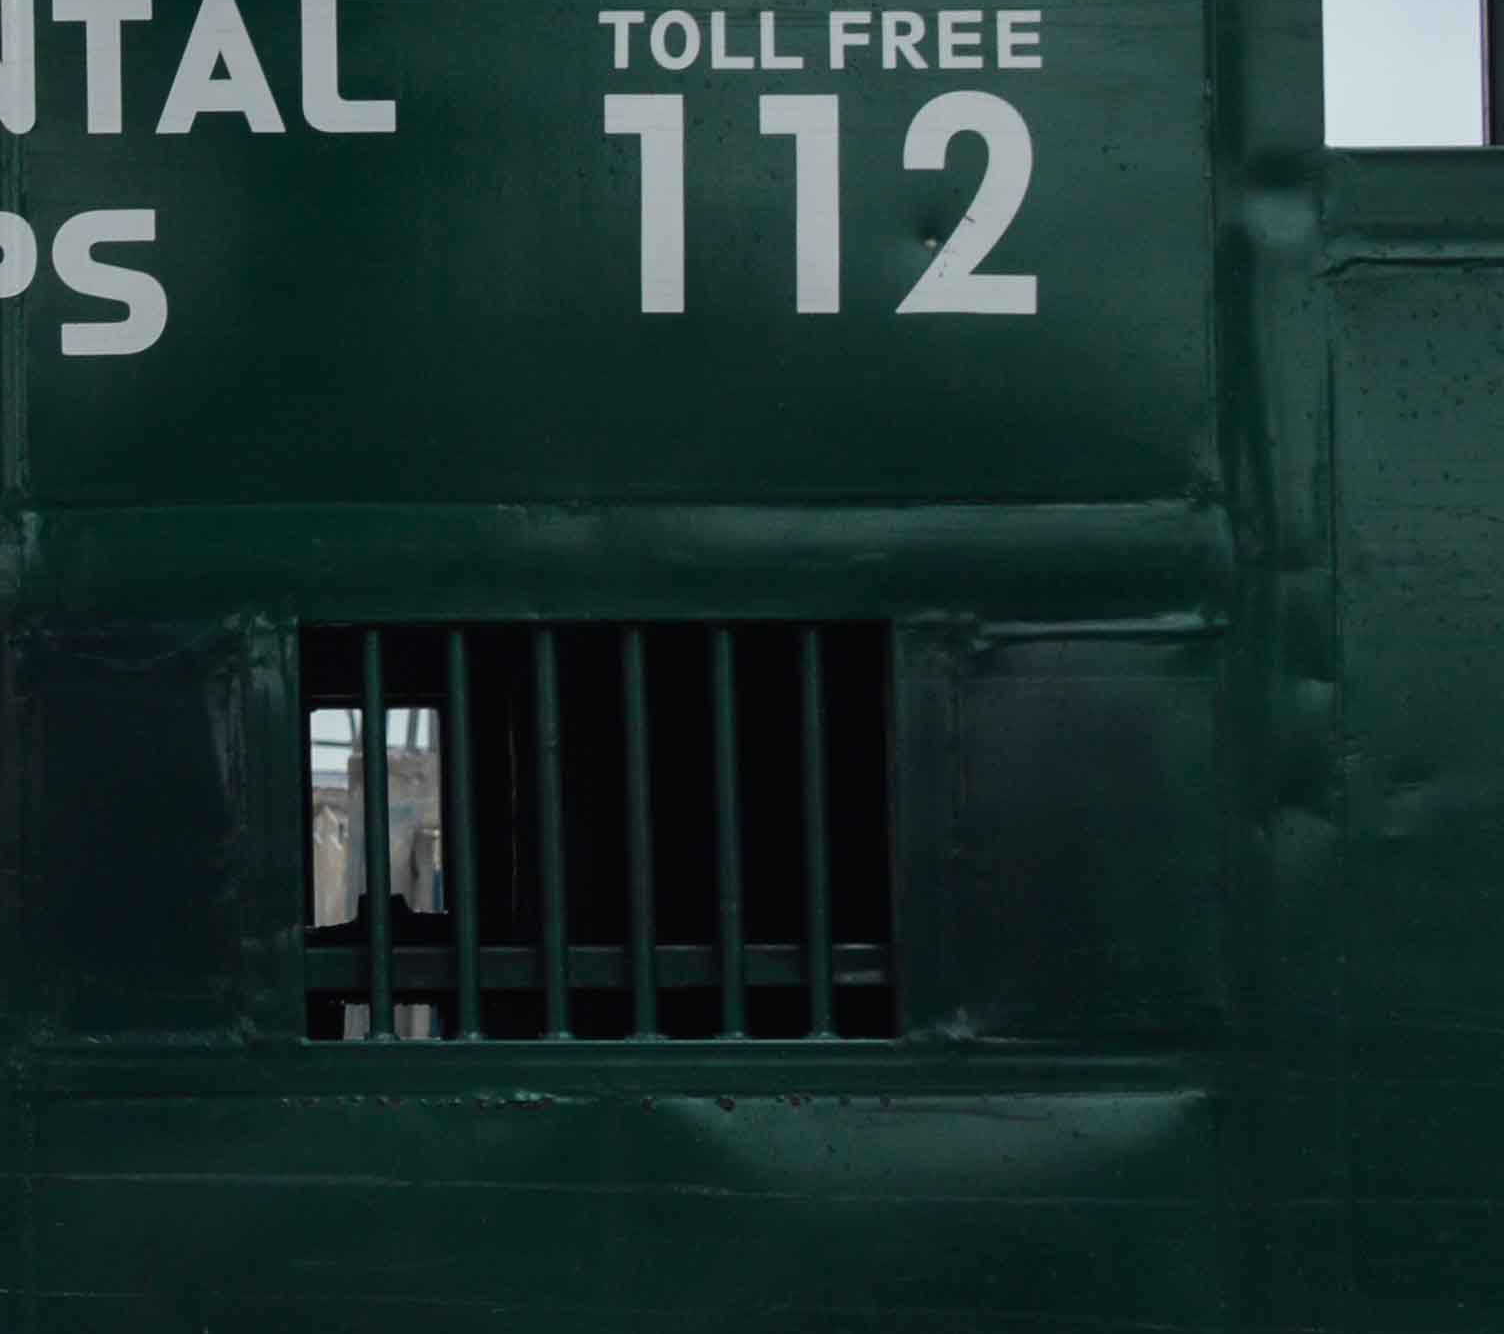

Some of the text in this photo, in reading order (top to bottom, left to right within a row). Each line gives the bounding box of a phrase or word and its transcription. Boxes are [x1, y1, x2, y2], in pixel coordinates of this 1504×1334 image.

[597, 9, 1044, 72] TOLL FREE
[602, 90, 1040, 316] 112
